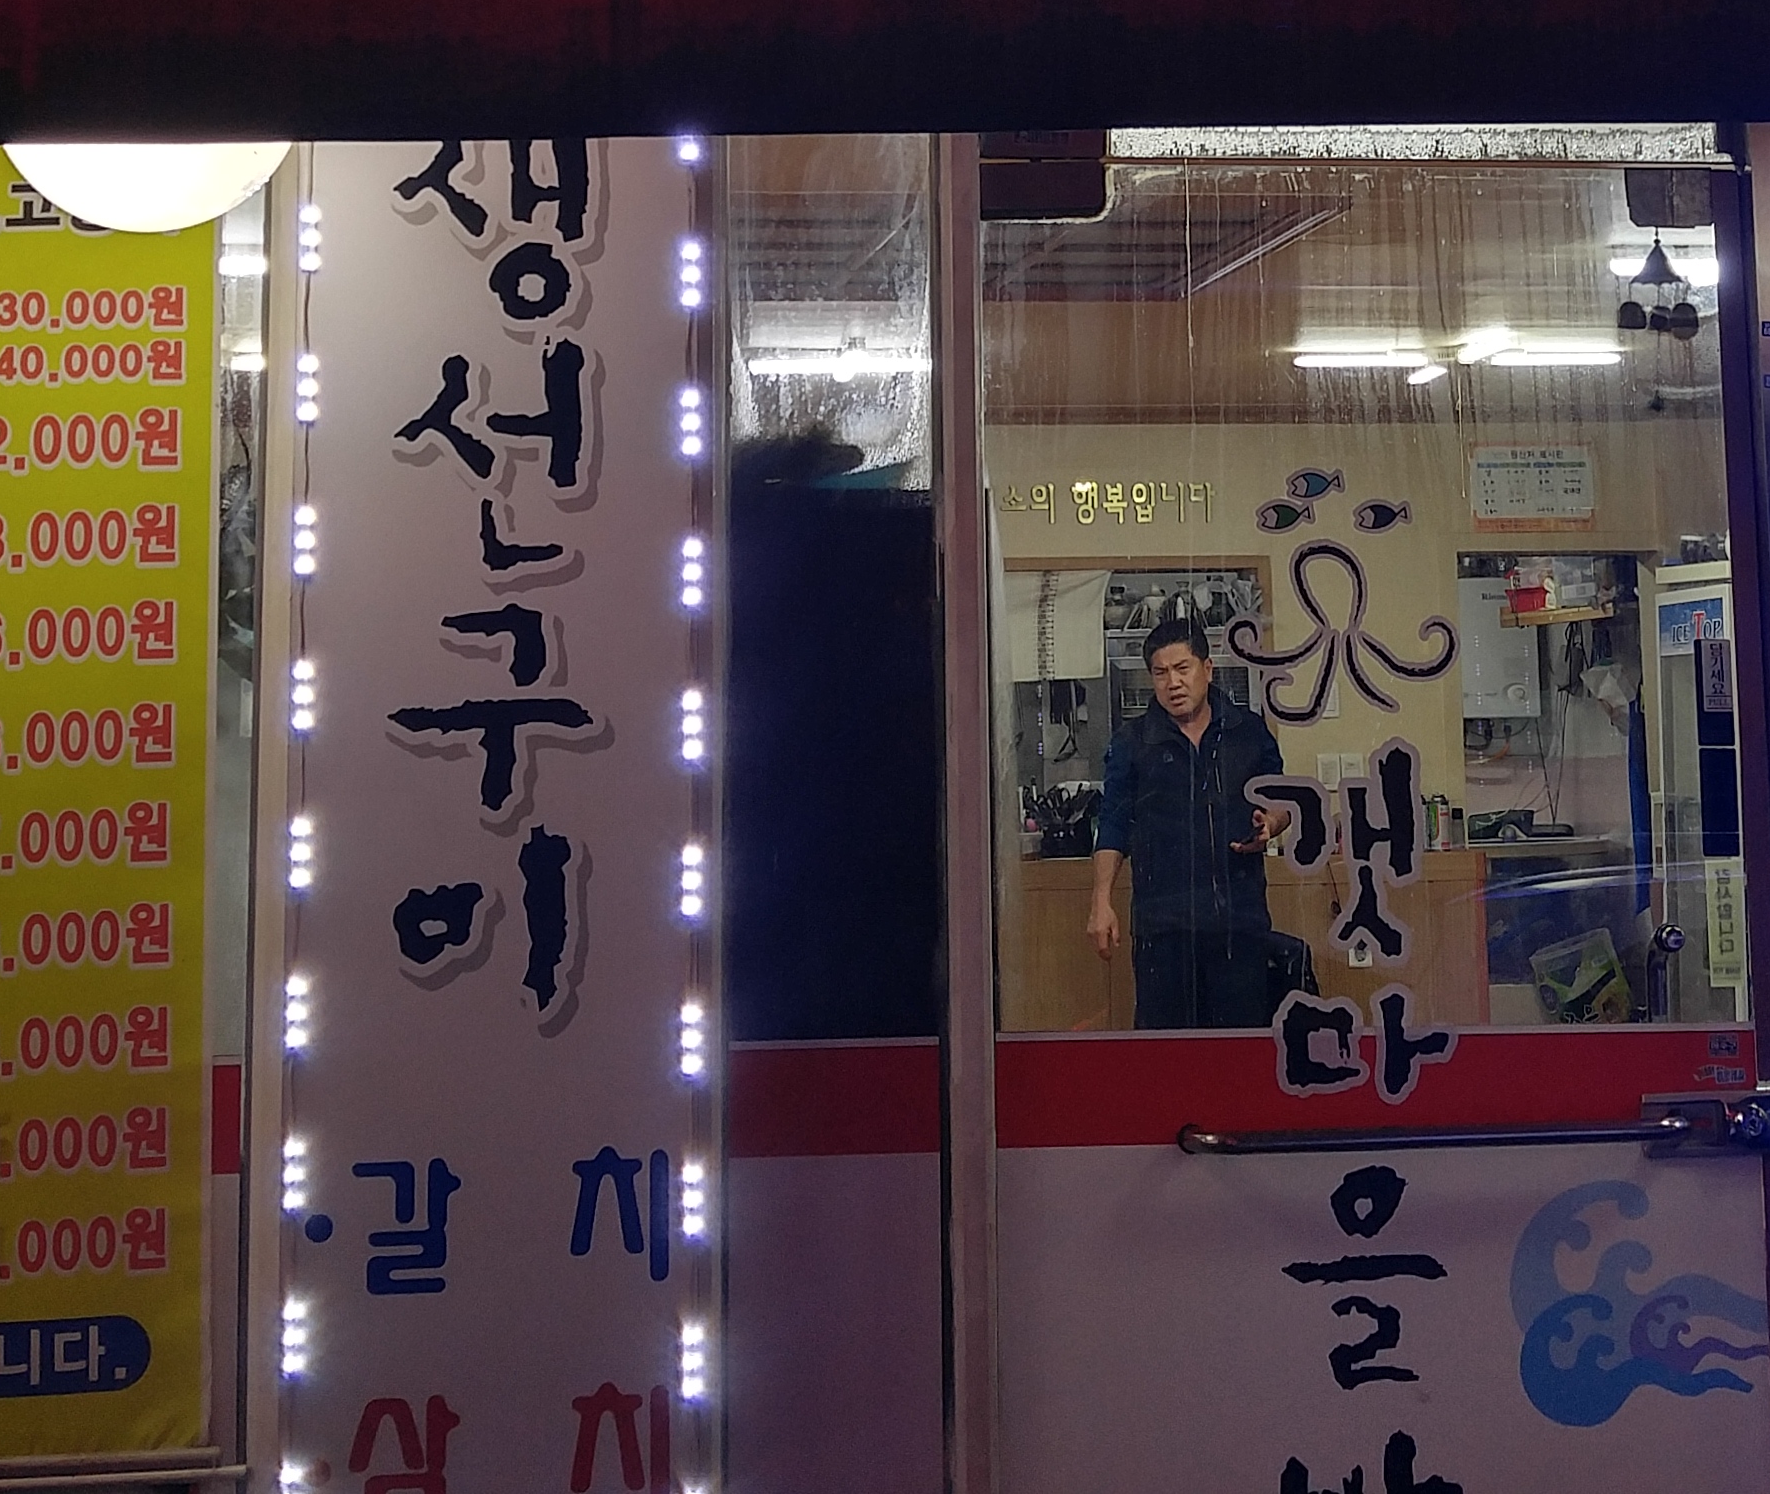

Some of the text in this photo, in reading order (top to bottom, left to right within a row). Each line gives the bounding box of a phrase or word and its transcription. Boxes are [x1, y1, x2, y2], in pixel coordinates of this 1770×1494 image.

[1071, 480, 1217, 525] 행복입니다
[1672, 611, 1722, 643] ICE TOP
